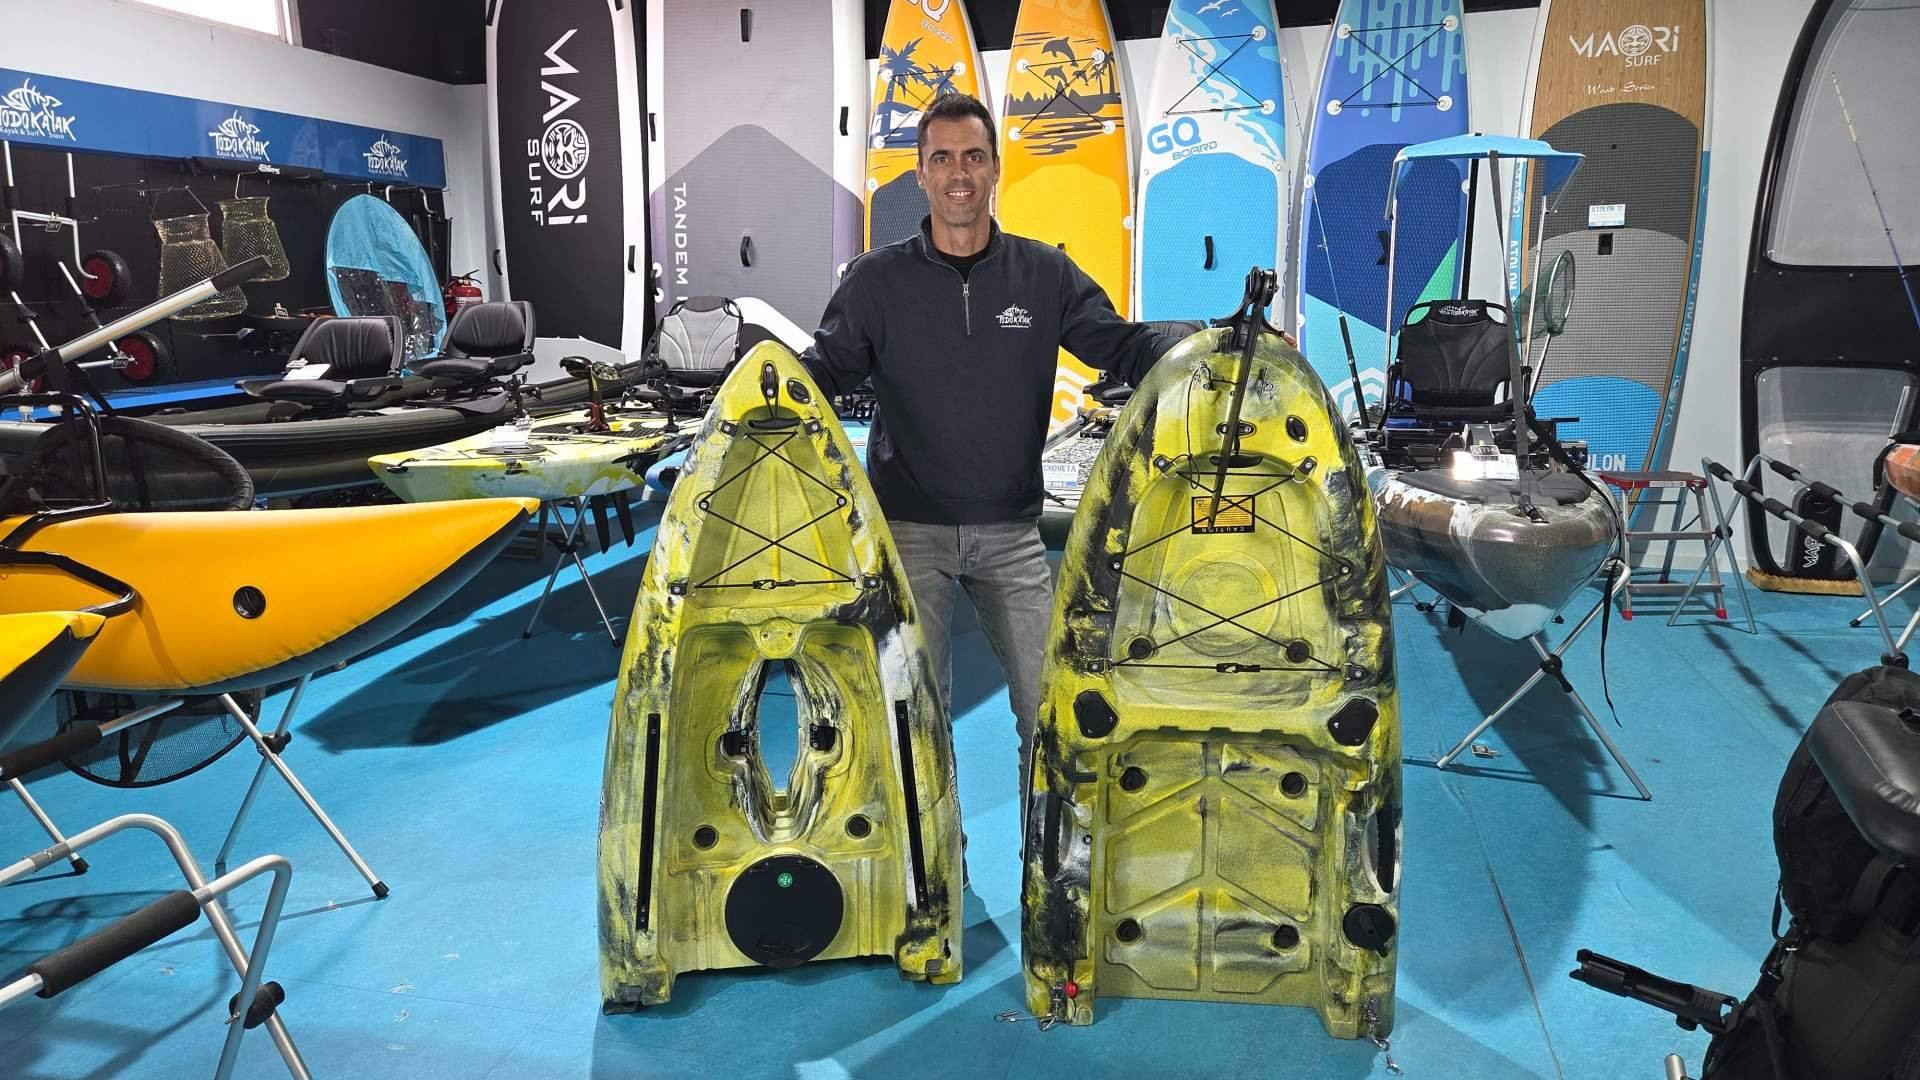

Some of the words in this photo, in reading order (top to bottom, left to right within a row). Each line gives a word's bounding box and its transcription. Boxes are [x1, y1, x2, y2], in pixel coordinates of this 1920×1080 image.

[1624, 54, 1662, 68] SURF
[1147, 116, 1202, 155] GQ
[1171, 140, 1218, 160] BOARD
[527, 138, 544, 227] SURF
[673, 182, 689, 285] TANDEM
[1042, 464, 1077, 473] CHOVETA
